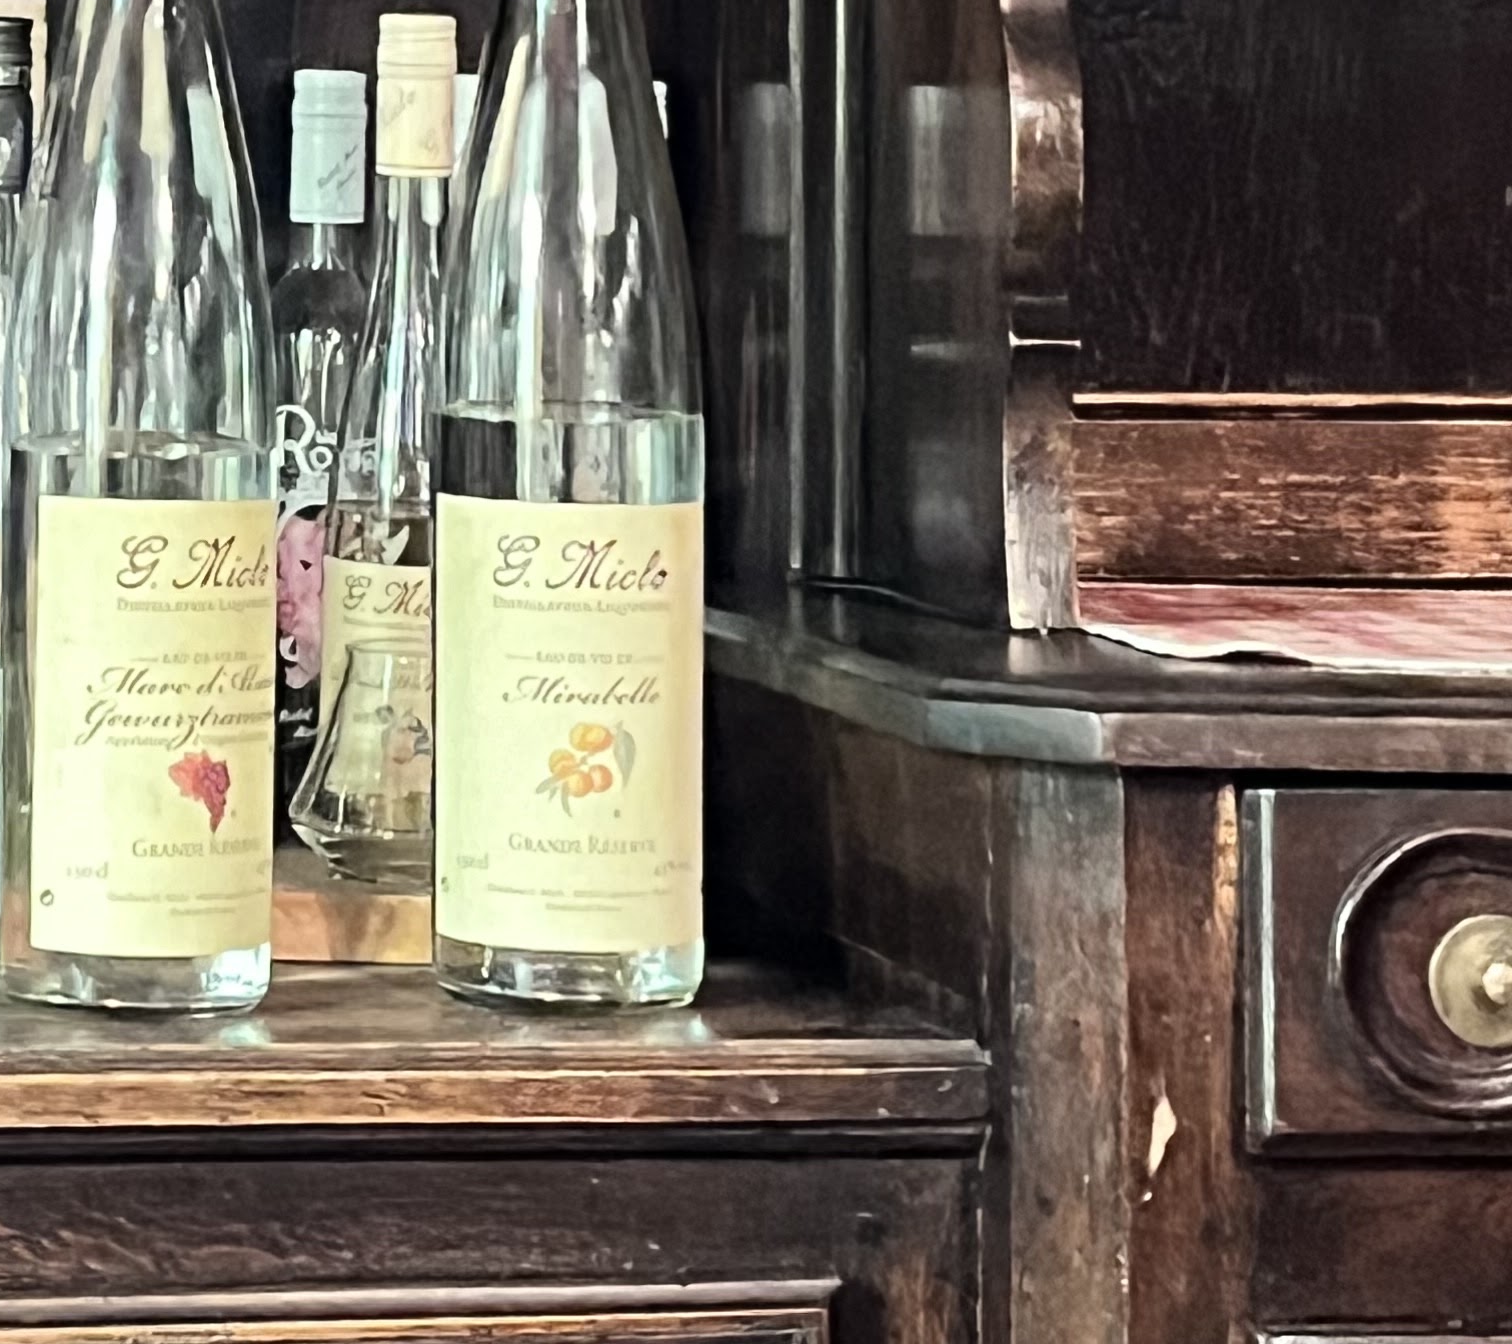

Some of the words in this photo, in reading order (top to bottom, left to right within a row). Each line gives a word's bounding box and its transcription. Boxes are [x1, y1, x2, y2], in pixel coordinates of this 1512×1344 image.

[115, 534, 169, 590] G.
[492, 534, 541, 588] G.
[545, 539, 668, 591] Miclo
[502, 675, 661, 705] Mirabelle
